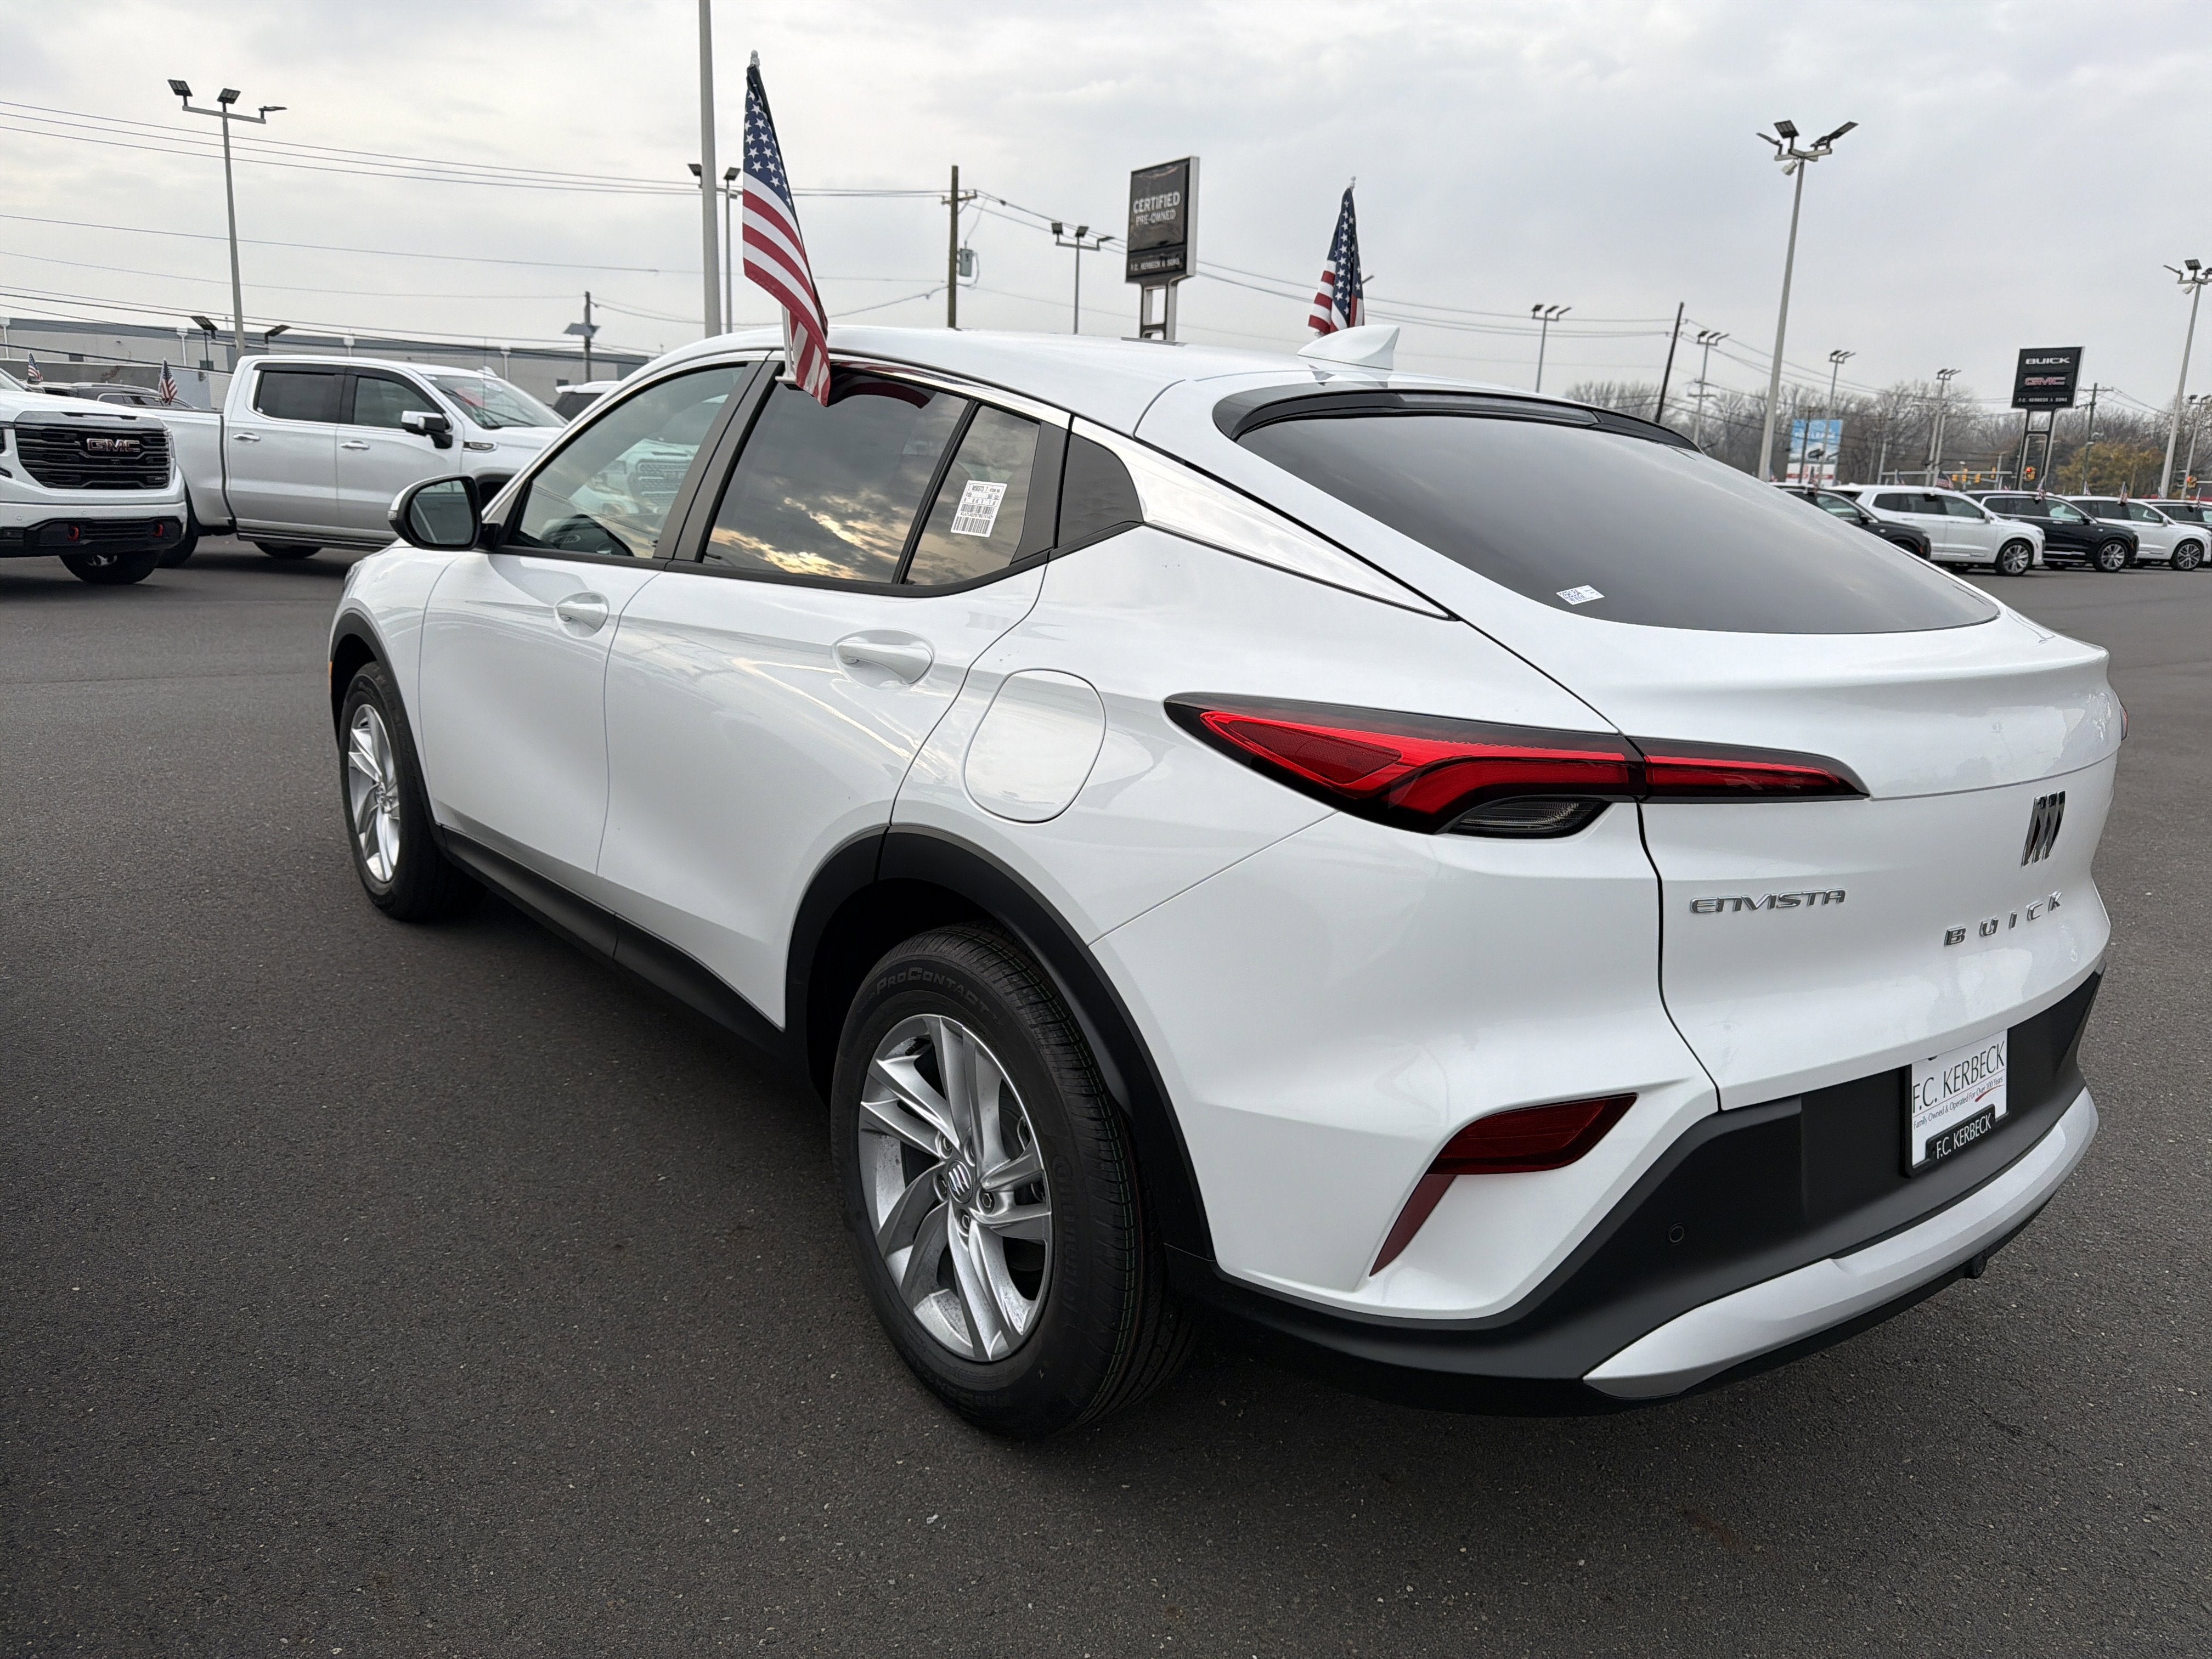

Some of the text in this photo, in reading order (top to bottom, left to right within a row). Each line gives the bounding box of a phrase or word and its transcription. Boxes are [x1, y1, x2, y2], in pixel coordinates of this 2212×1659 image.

[1133, 191, 1181, 214] CERTIFIED
[1136, 208, 1176, 226] PRE-OWNED
[2025, 357, 2070, 365] BUICK
[2024, 376, 2066, 386] GMC
[87, 438, 141, 453] GMC
[1690, 887, 1846, 914] ENVISTA
[1944, 889, 2063, 946] BUICK
[1912, 1040, 2005, 1113] F.C. KERBECK
[1914, 1115, 1927, 1130] Family
[1928, 1105, 1945, 1121] Owned
[1945, 1104, 1949, 1113] &
[1949, 1093, 1969, 1111] Operated
[1976, 1086, 1985, 1096] Over
[1993, 1076, 2003, 1086] Years
[1936, 1113, 1991, 1159] F.C. KERBECK
